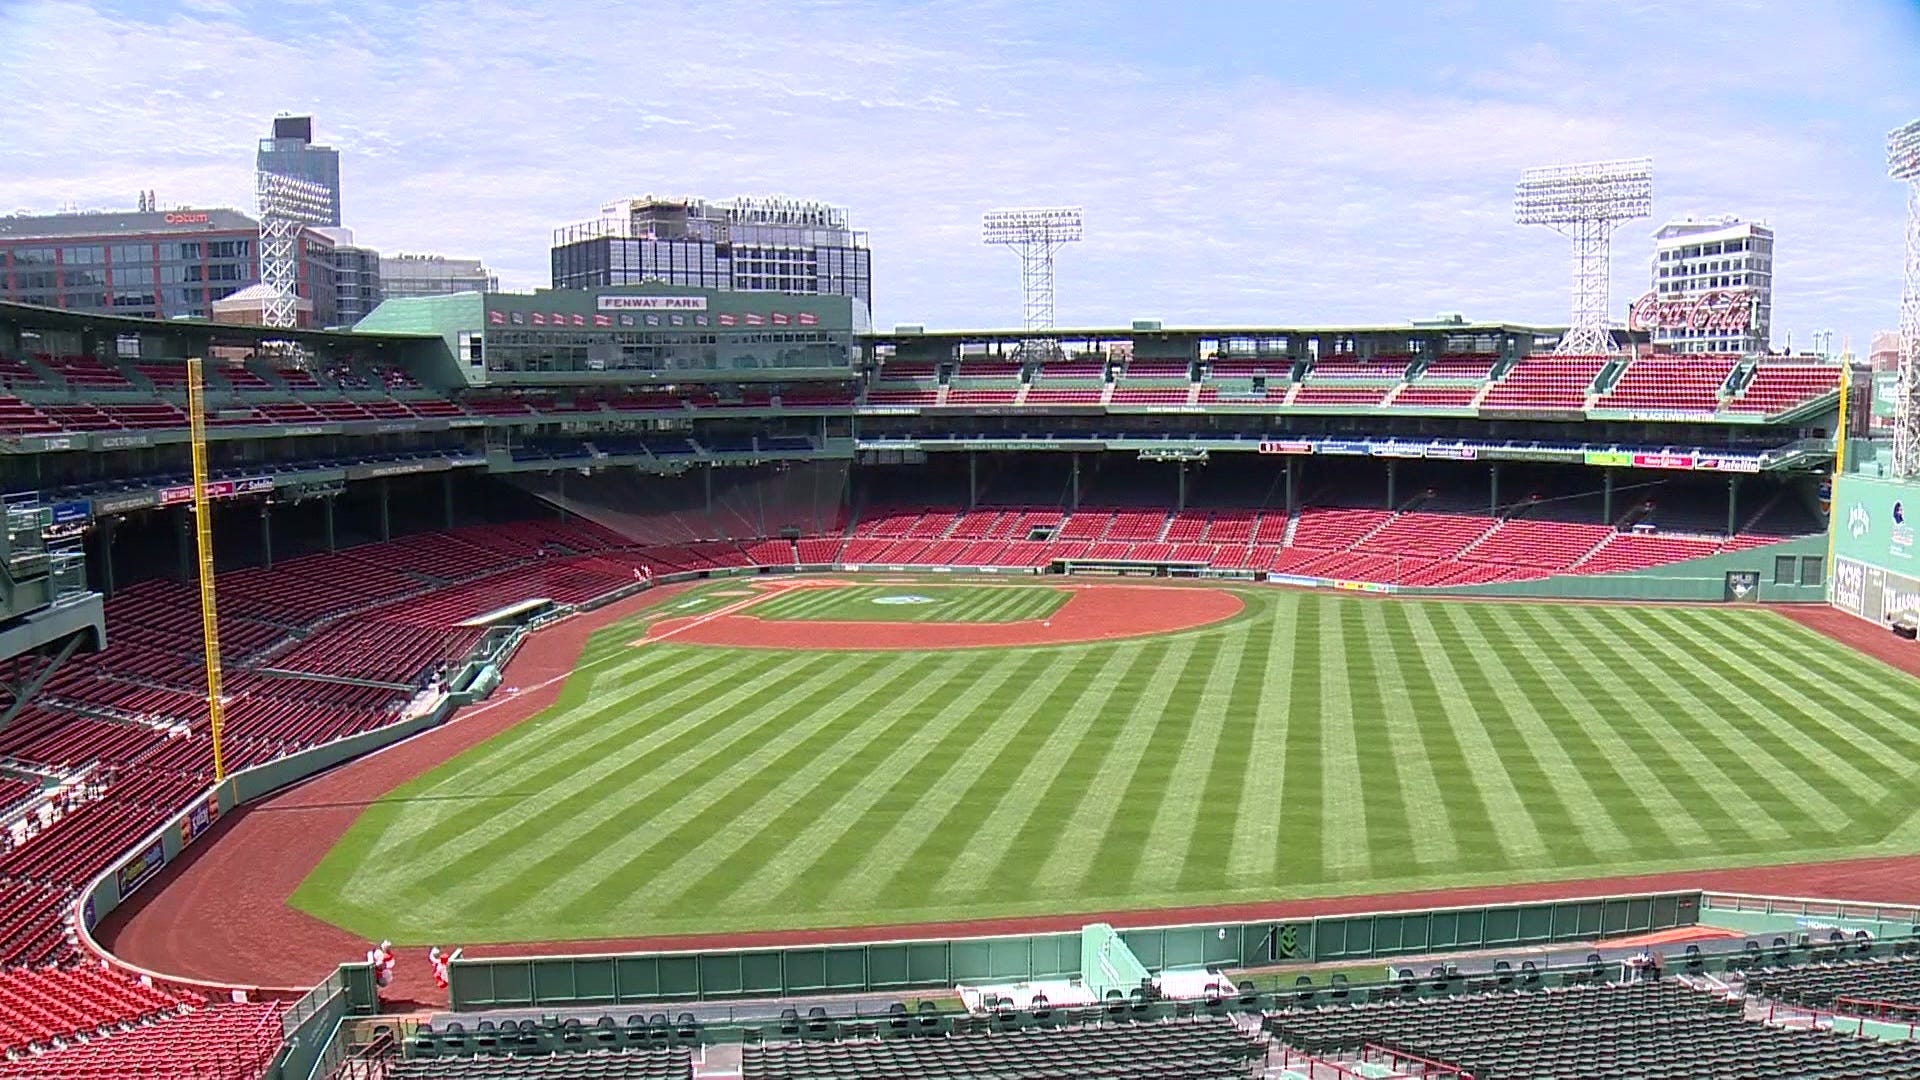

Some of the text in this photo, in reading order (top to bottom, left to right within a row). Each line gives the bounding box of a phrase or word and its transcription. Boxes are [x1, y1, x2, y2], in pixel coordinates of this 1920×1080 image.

[165, 213, 208, 225] Optum
[604, 298, 700, 308] FENWAY PARK
[1845, 565, 1861, 589] CVS
